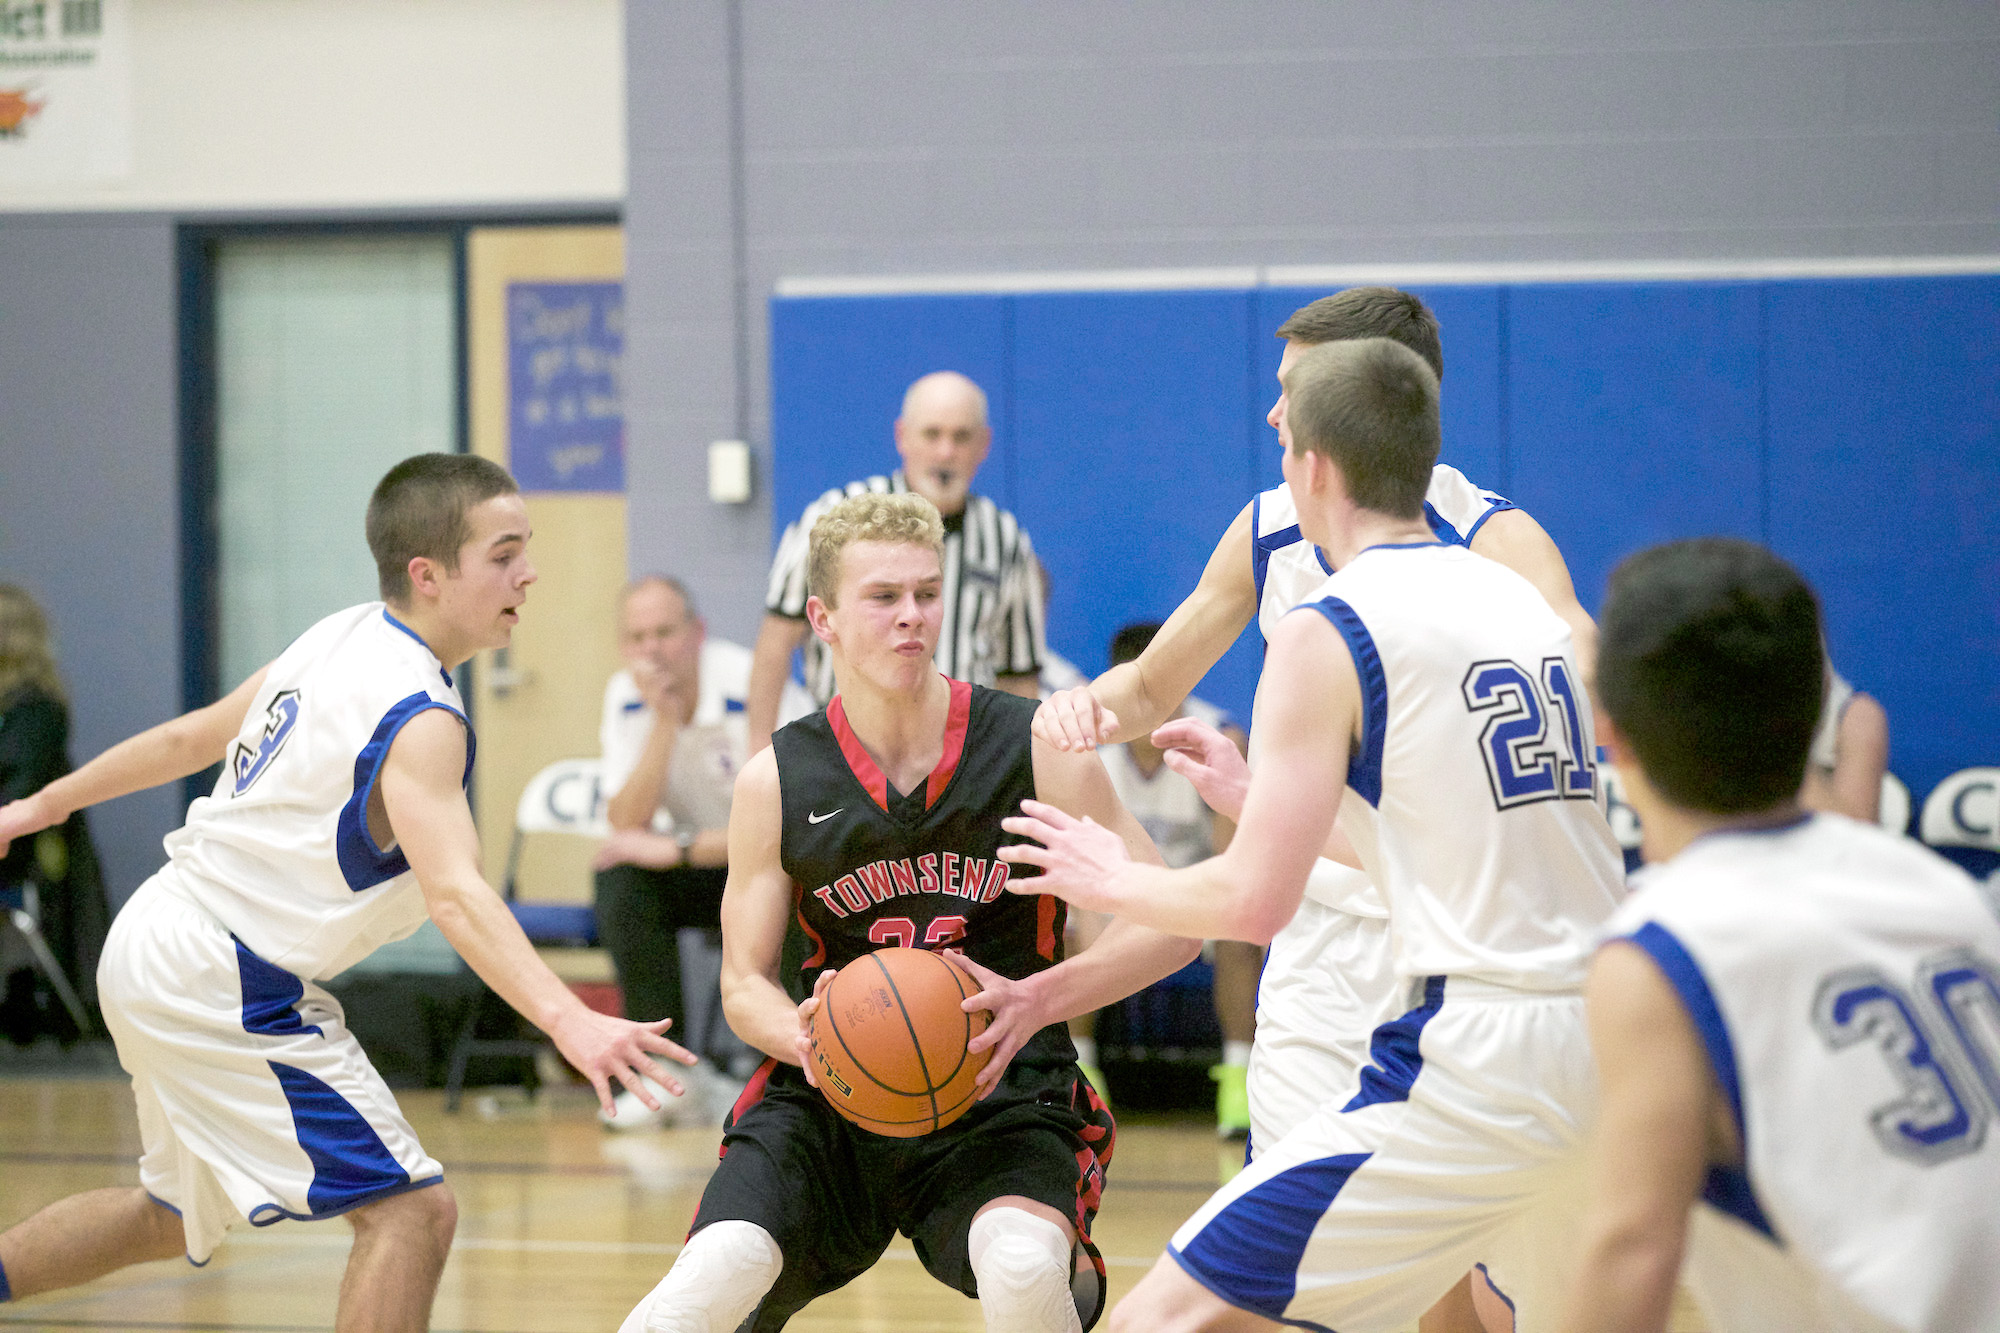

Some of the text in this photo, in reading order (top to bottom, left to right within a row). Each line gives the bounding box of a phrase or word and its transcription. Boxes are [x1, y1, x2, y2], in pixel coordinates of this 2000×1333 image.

[231, 687, 301, 799] 3
[1462, 656, 1597, 812] 21
[813, 851, 1011, 918] TOWNSEND
[1811, 948, 2000, 1168] 30
